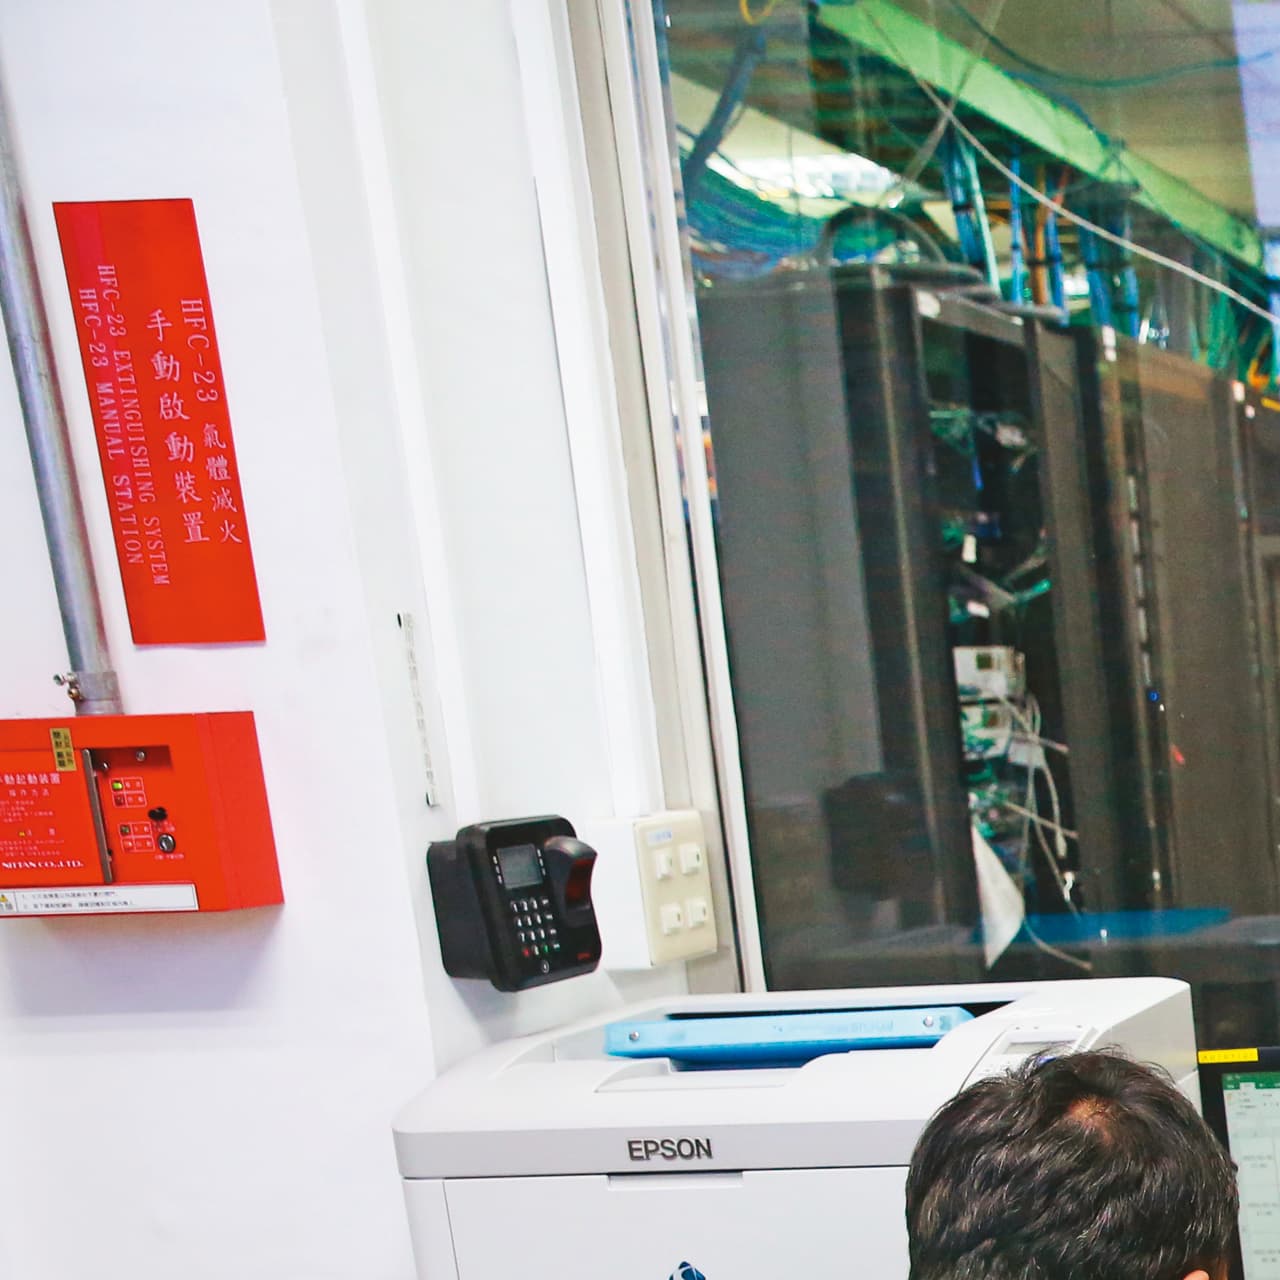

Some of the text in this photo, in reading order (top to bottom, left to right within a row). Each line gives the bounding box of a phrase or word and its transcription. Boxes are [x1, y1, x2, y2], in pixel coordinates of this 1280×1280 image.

[79, 288, 144, 564] HFC-23 MANUAL STATION
[97, 264, 170, 585] HFC-23 EXTINGUISHING SYSTEM
[180, 298, 243, 544] HFC-23 氣體滅火
[627, 1137, 713, 1161] EPSON
